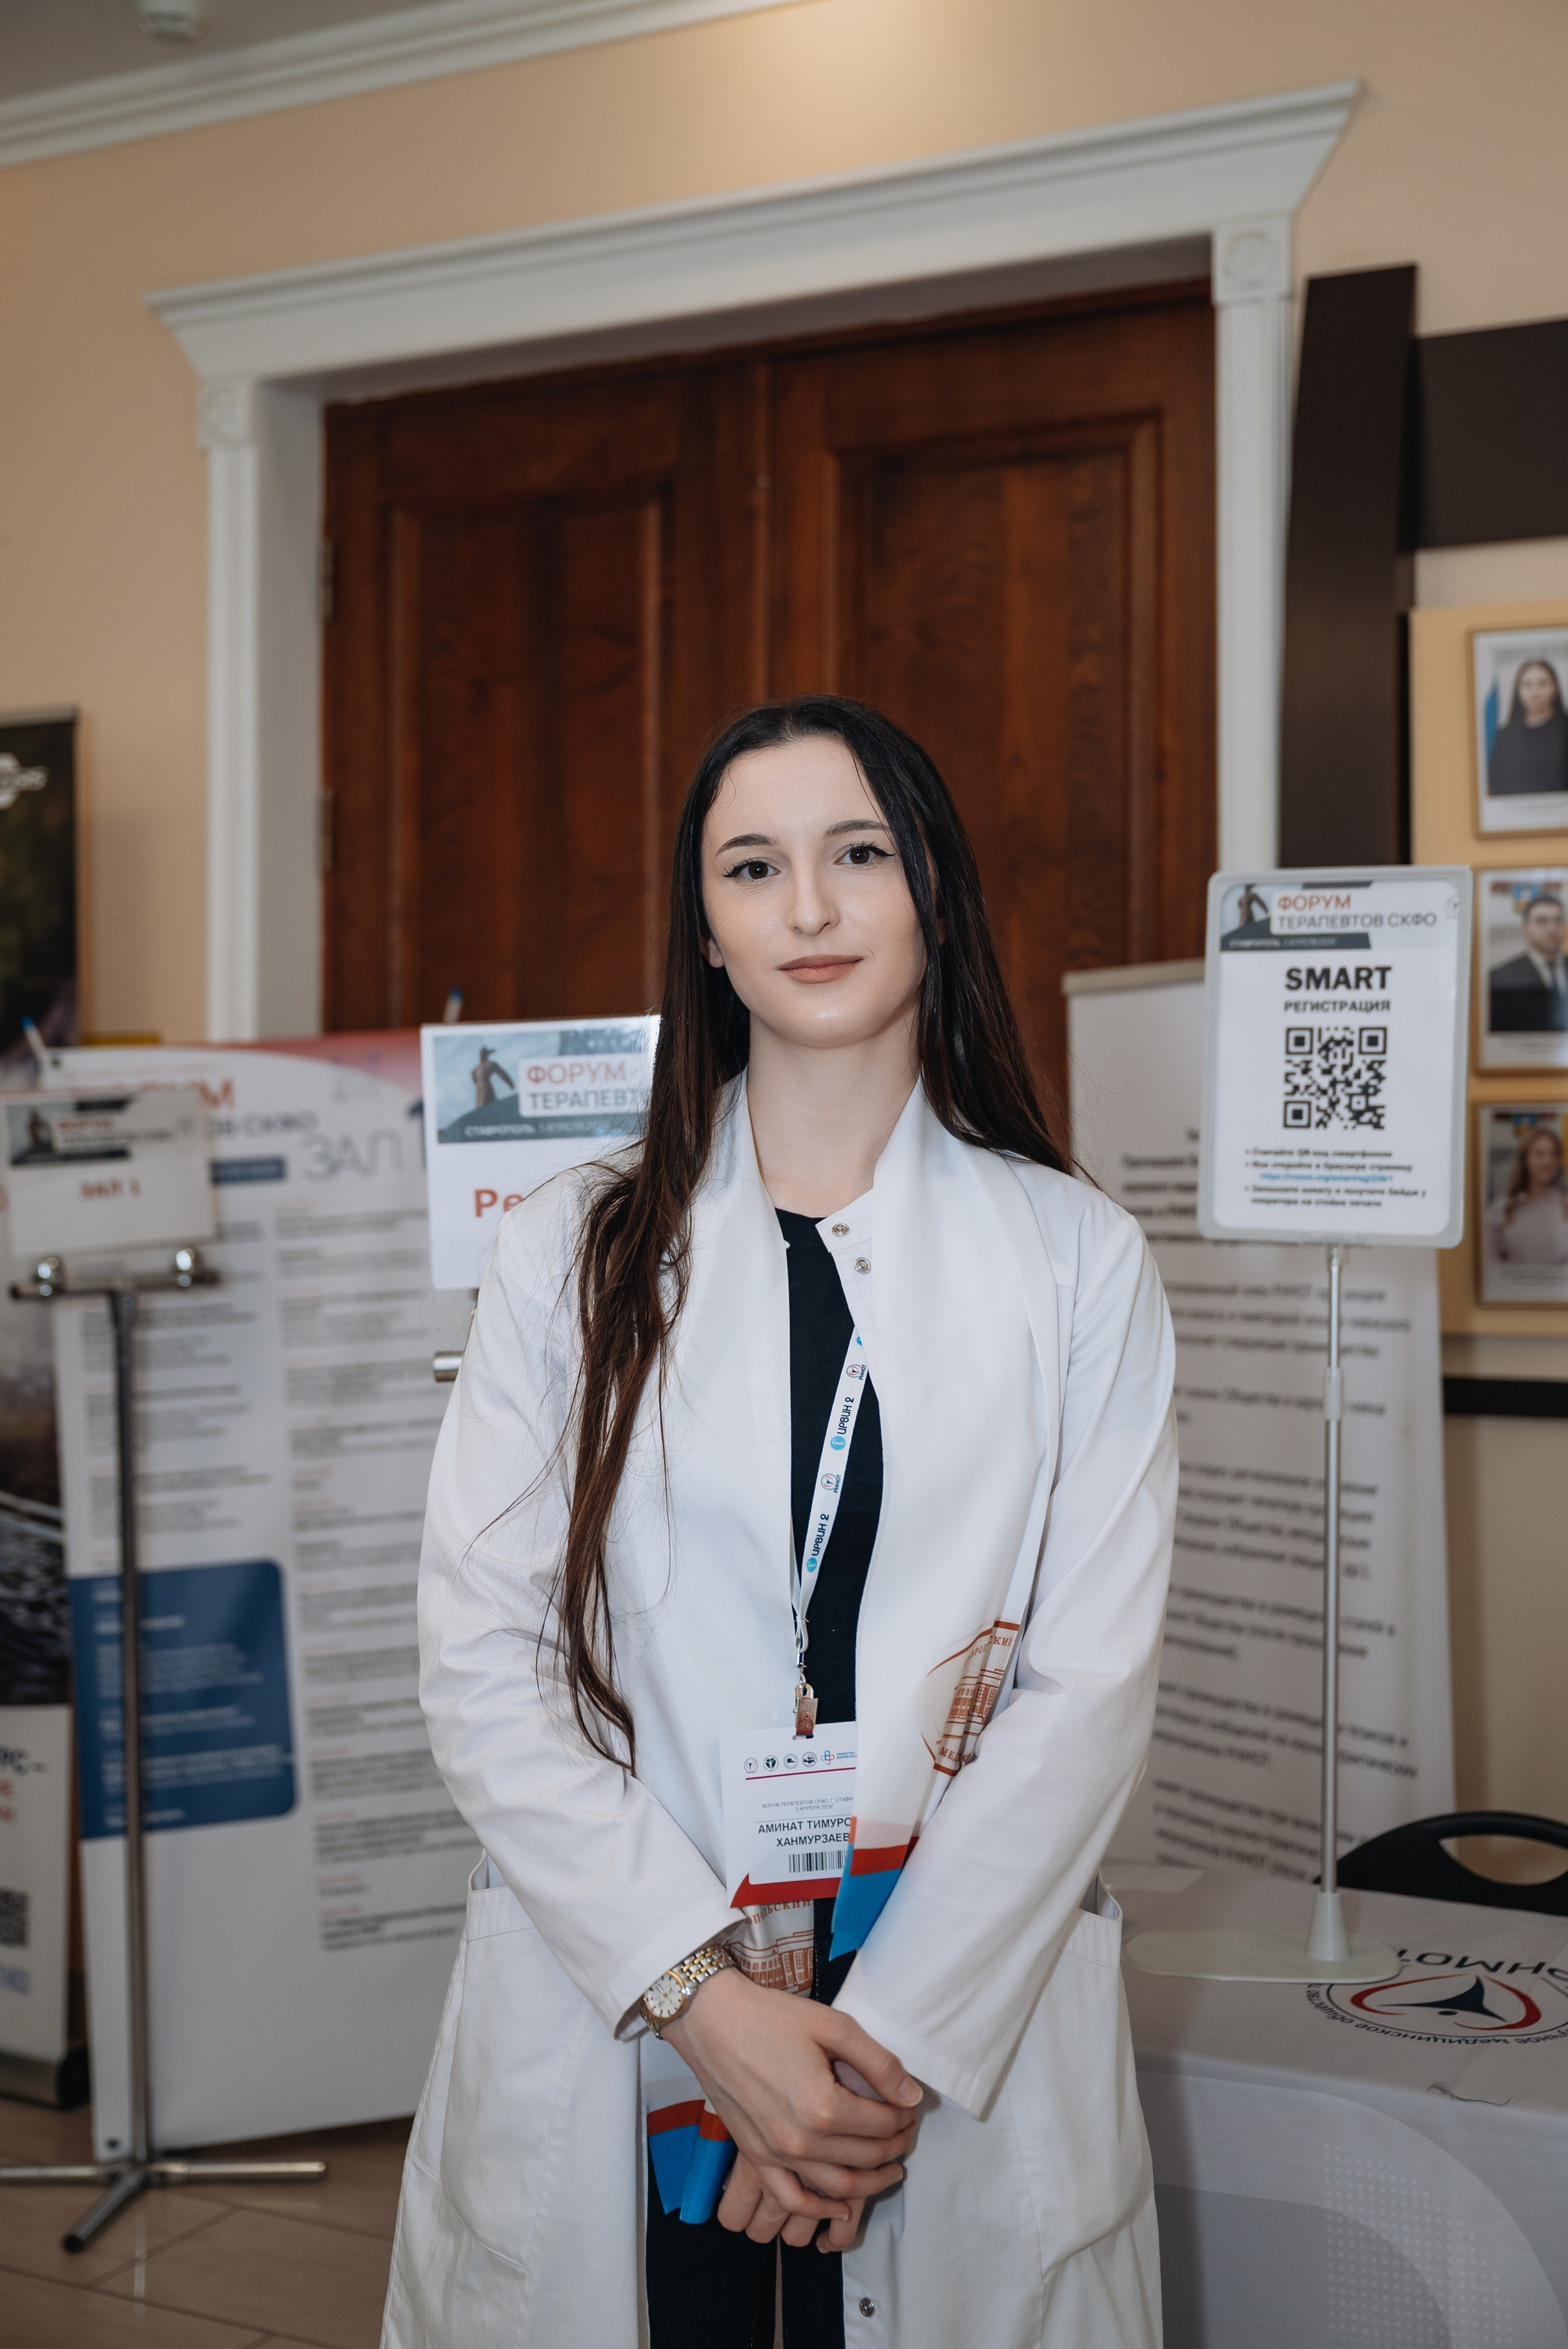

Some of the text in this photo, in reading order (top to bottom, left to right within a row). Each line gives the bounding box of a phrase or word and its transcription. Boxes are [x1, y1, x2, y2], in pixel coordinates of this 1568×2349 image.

[1278, 894, 1351, 911] ФОРУМ
[1278, 910, 1437, 930] ТЕРАПЕВТОВ СКФО
[1285, 966, 1392, 992] SMART
[1284, 999, 1390, 1013] РЕГИСТРАЦИЯ
[527, 1061, 627, 1084] ФОРУМ
[300, 1128, 405, 1184] ЗАЛ
[858, 1364, 867, 1381] РНМОТ
[833, 1474, 842, 1493] РНМОТ
[758, 1821, 803, 1834] АМИНАТ
[1354, 2023, 1510, 2045] медицинское
